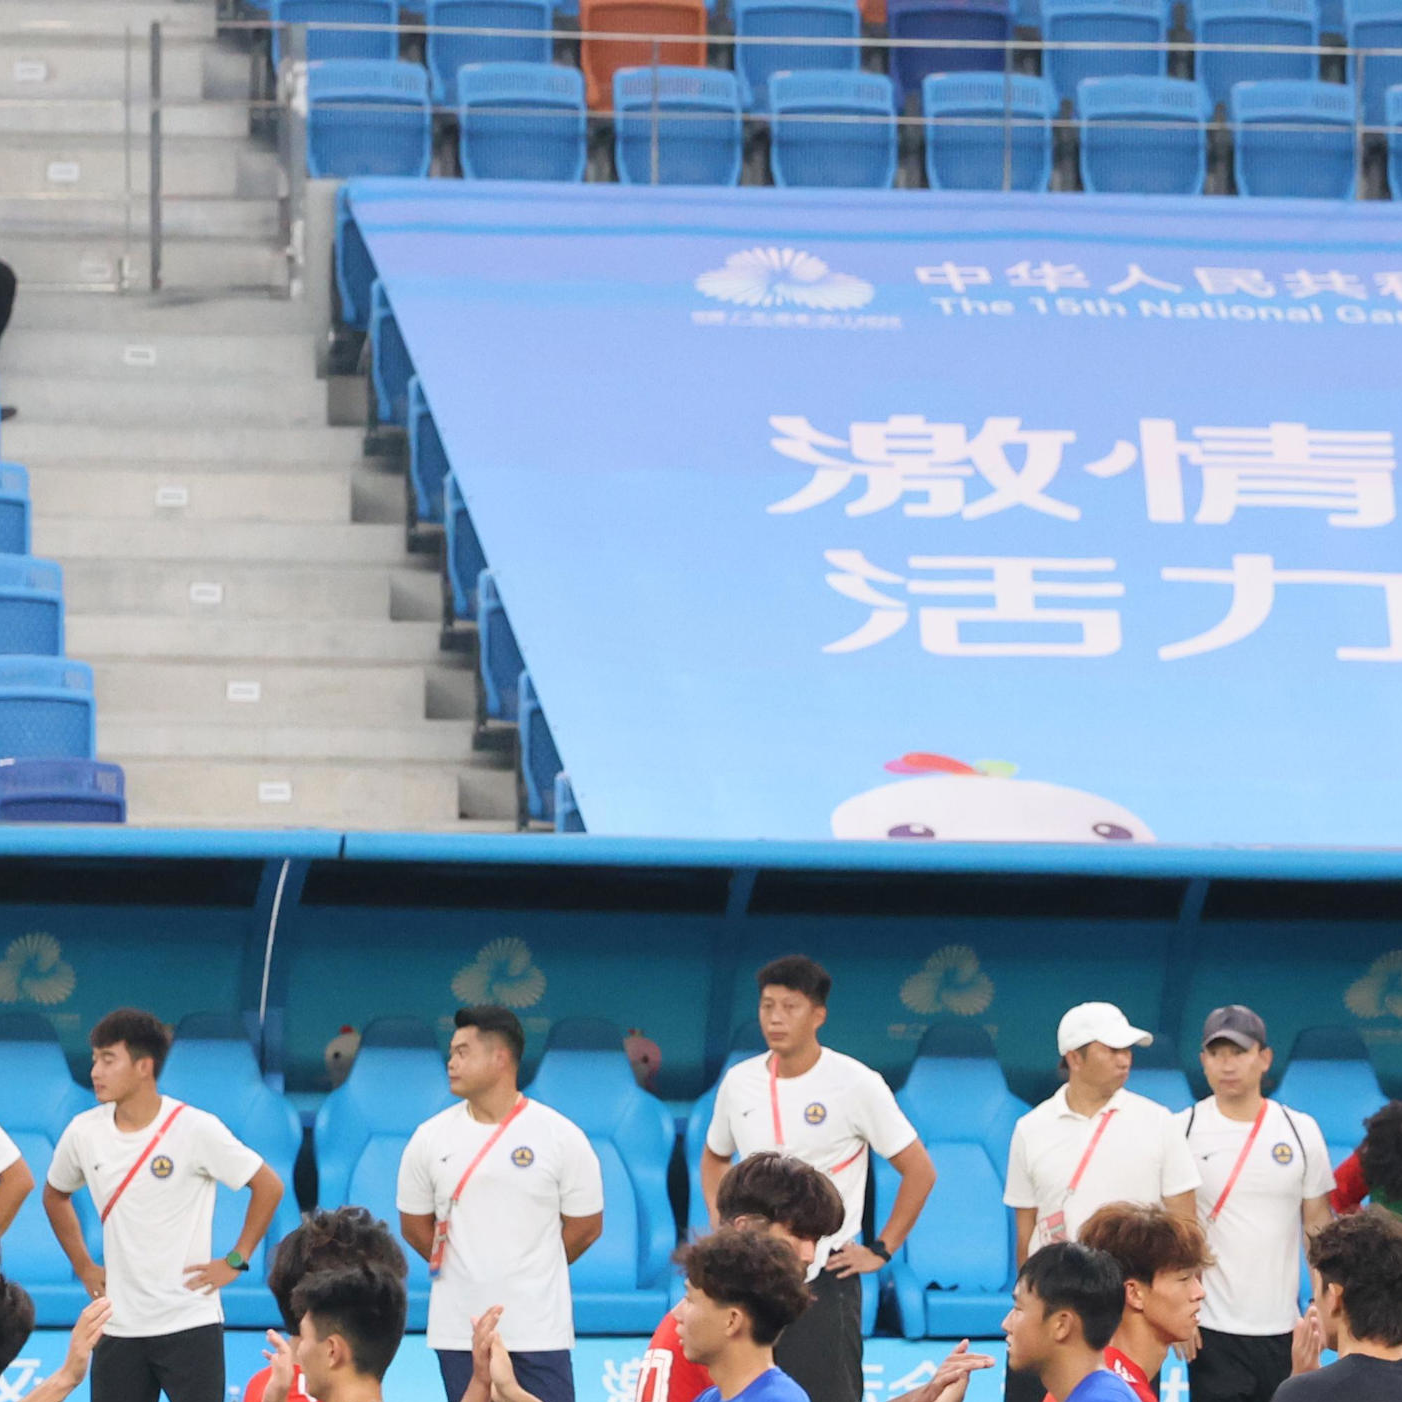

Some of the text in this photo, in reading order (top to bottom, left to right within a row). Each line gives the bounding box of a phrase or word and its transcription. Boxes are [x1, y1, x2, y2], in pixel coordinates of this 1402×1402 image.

[930, 295, 1014, 318] The
[1029, 296, 1128, 320] 15th
[1138, 298, 1325, 325] National
